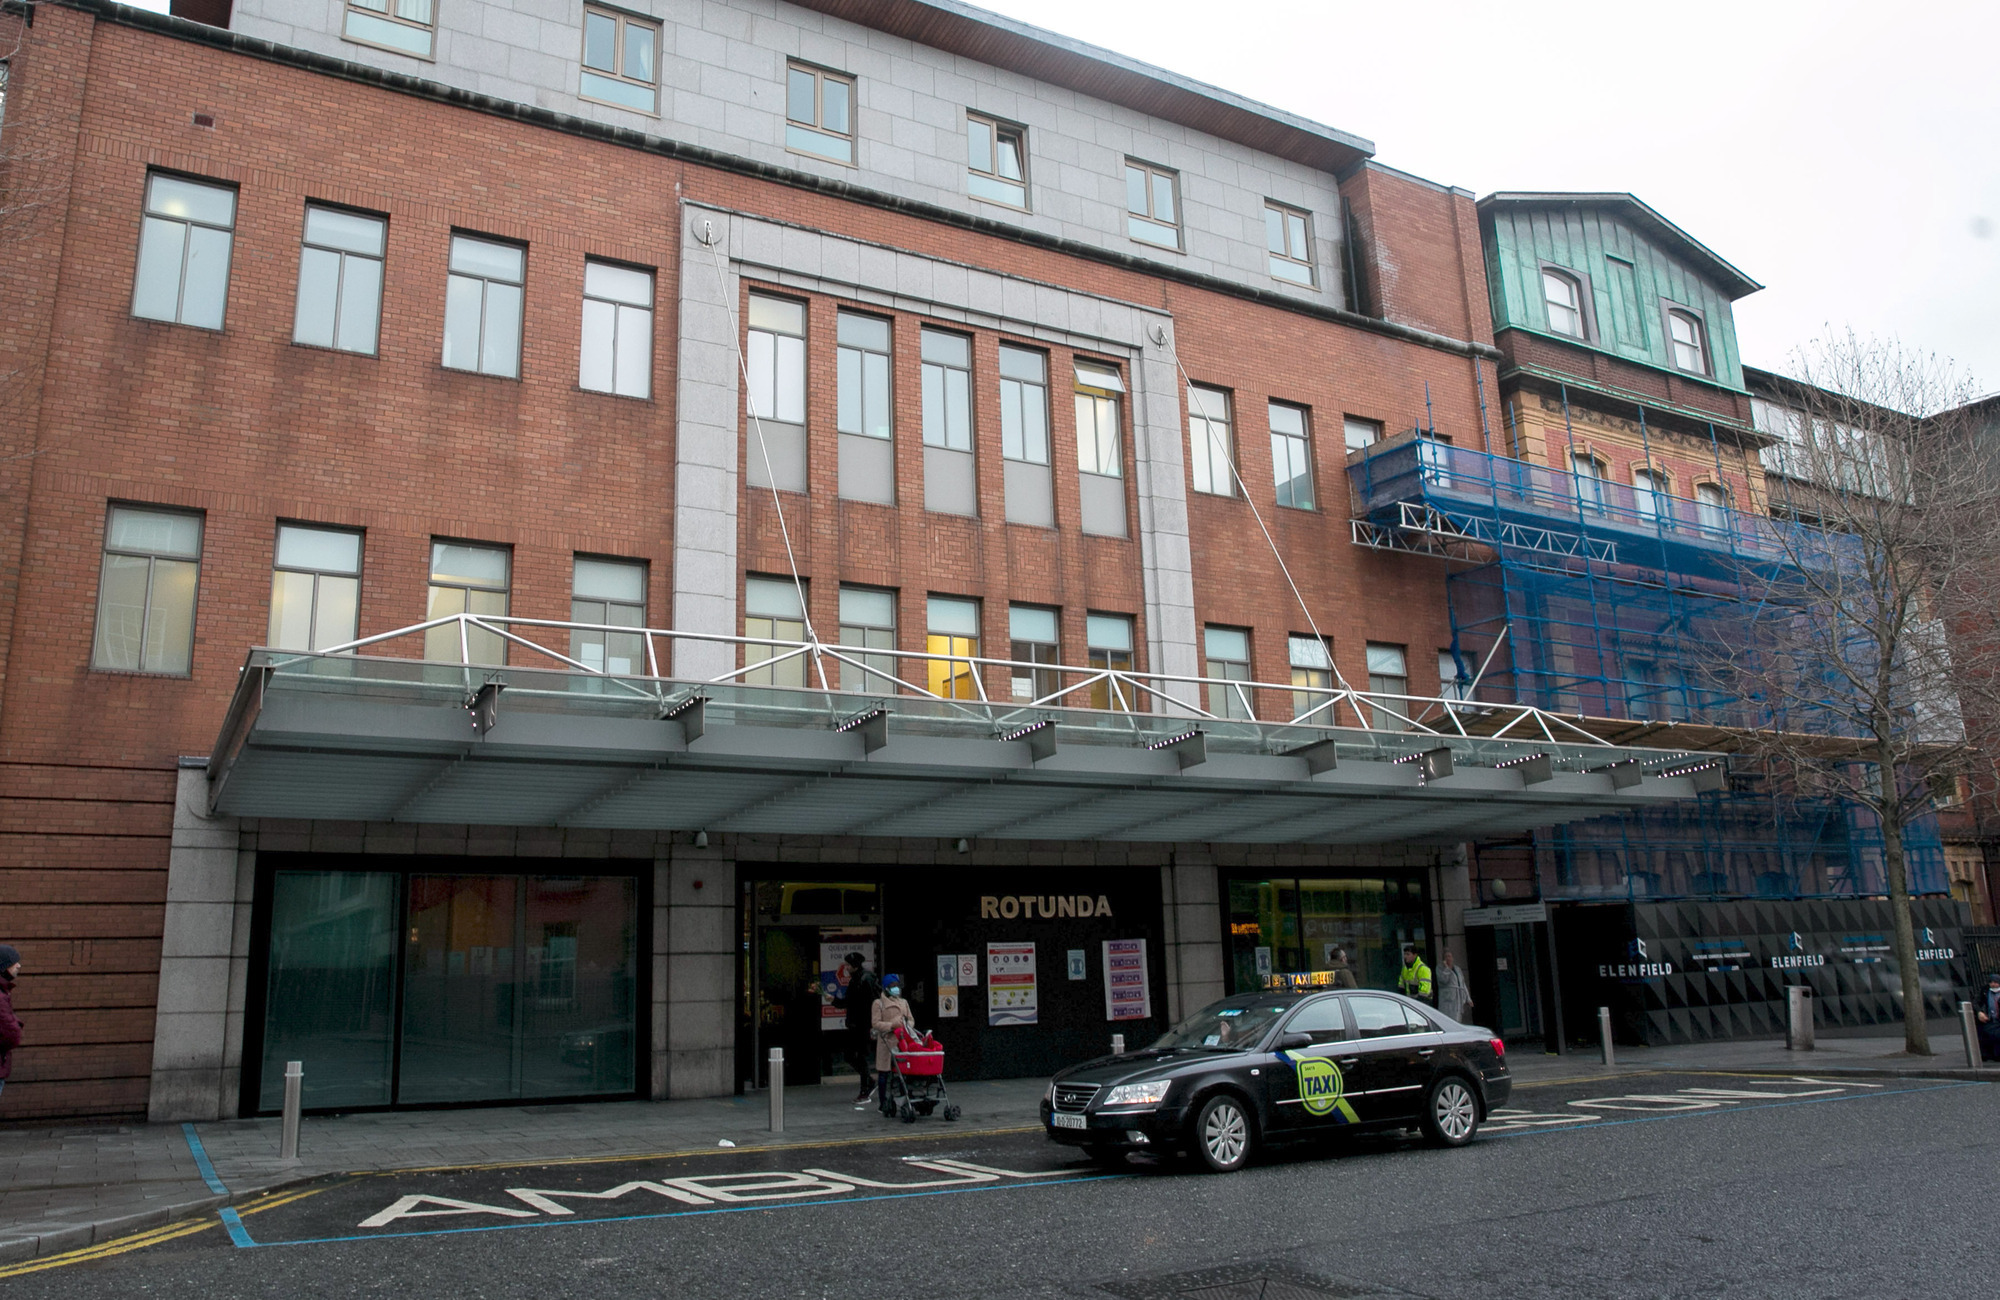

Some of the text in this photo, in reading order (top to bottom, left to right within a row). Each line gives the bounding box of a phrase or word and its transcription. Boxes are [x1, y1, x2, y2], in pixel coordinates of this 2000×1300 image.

[980, 895, 1113, 919] ROTUNDA
[1771, 954, 1825, 969] ELENFIELD
[1914, 948, 1954, 961] LENFIELD
[1598, 962, 1672, 977] ELENFIELD
[1290, 974, 1311, 986] TAXI
[1304, 1074, 1337, 1096] TAXI
[1567, 1077, 1884, 1112] ONLY
